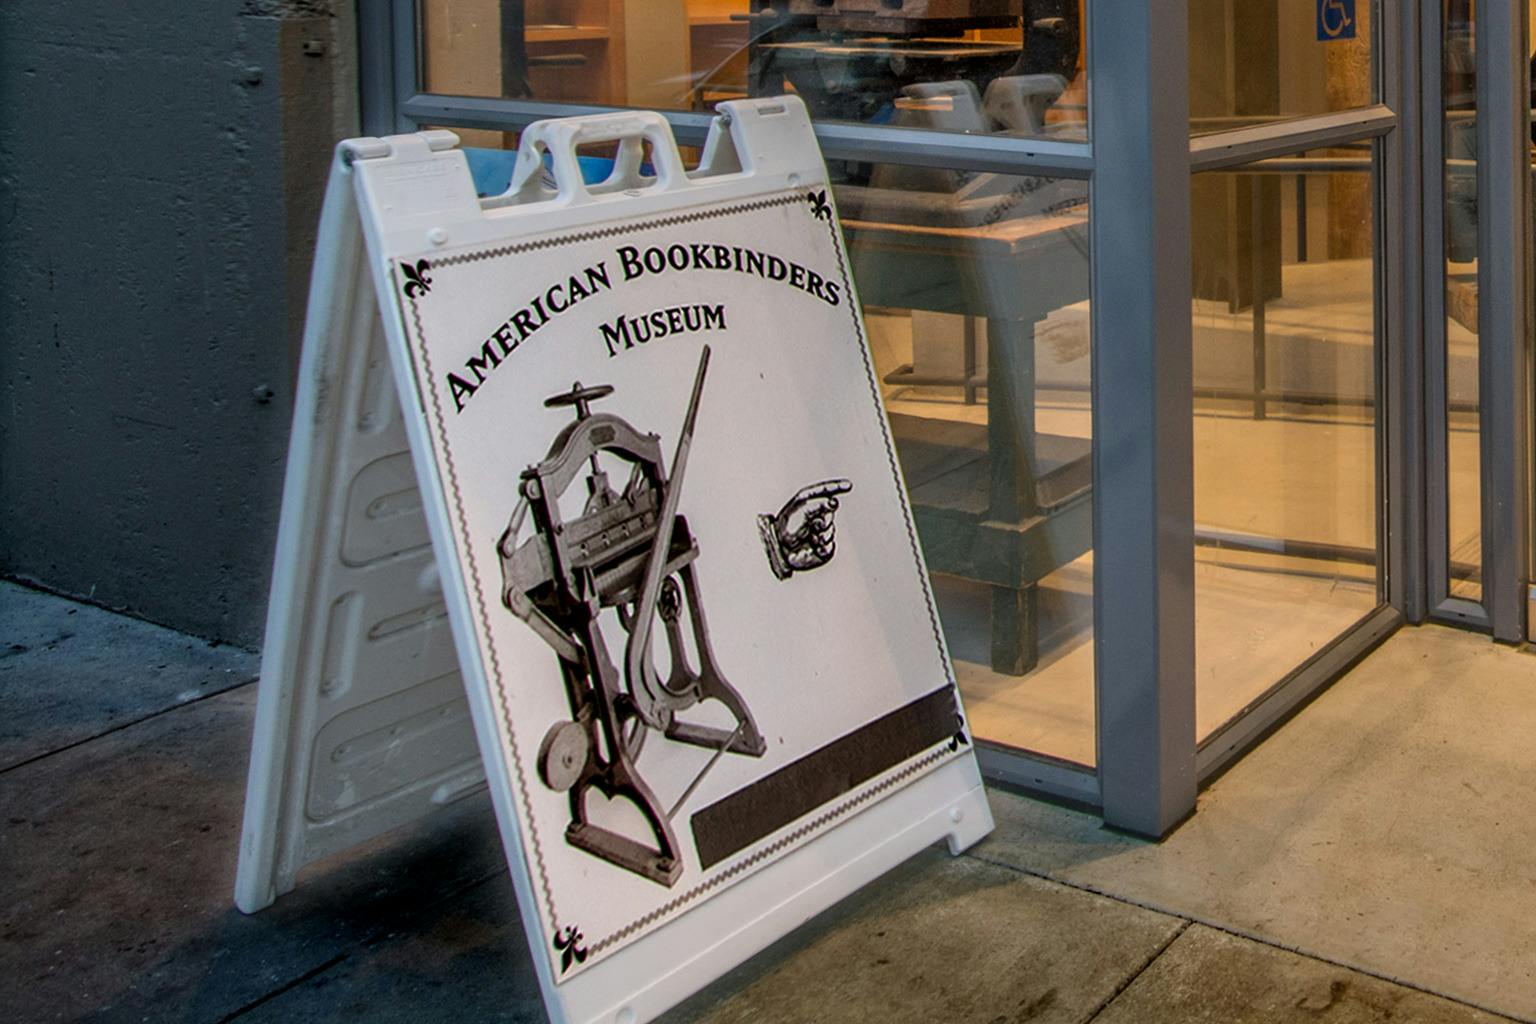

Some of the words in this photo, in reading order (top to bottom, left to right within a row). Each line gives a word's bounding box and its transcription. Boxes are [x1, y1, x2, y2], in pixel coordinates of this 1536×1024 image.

[445, 261, 613, 415] AMERICAN
[616, 243, 842, 307] BOOKBINDERS
[598, 303, 728, 358] MUSEUM
